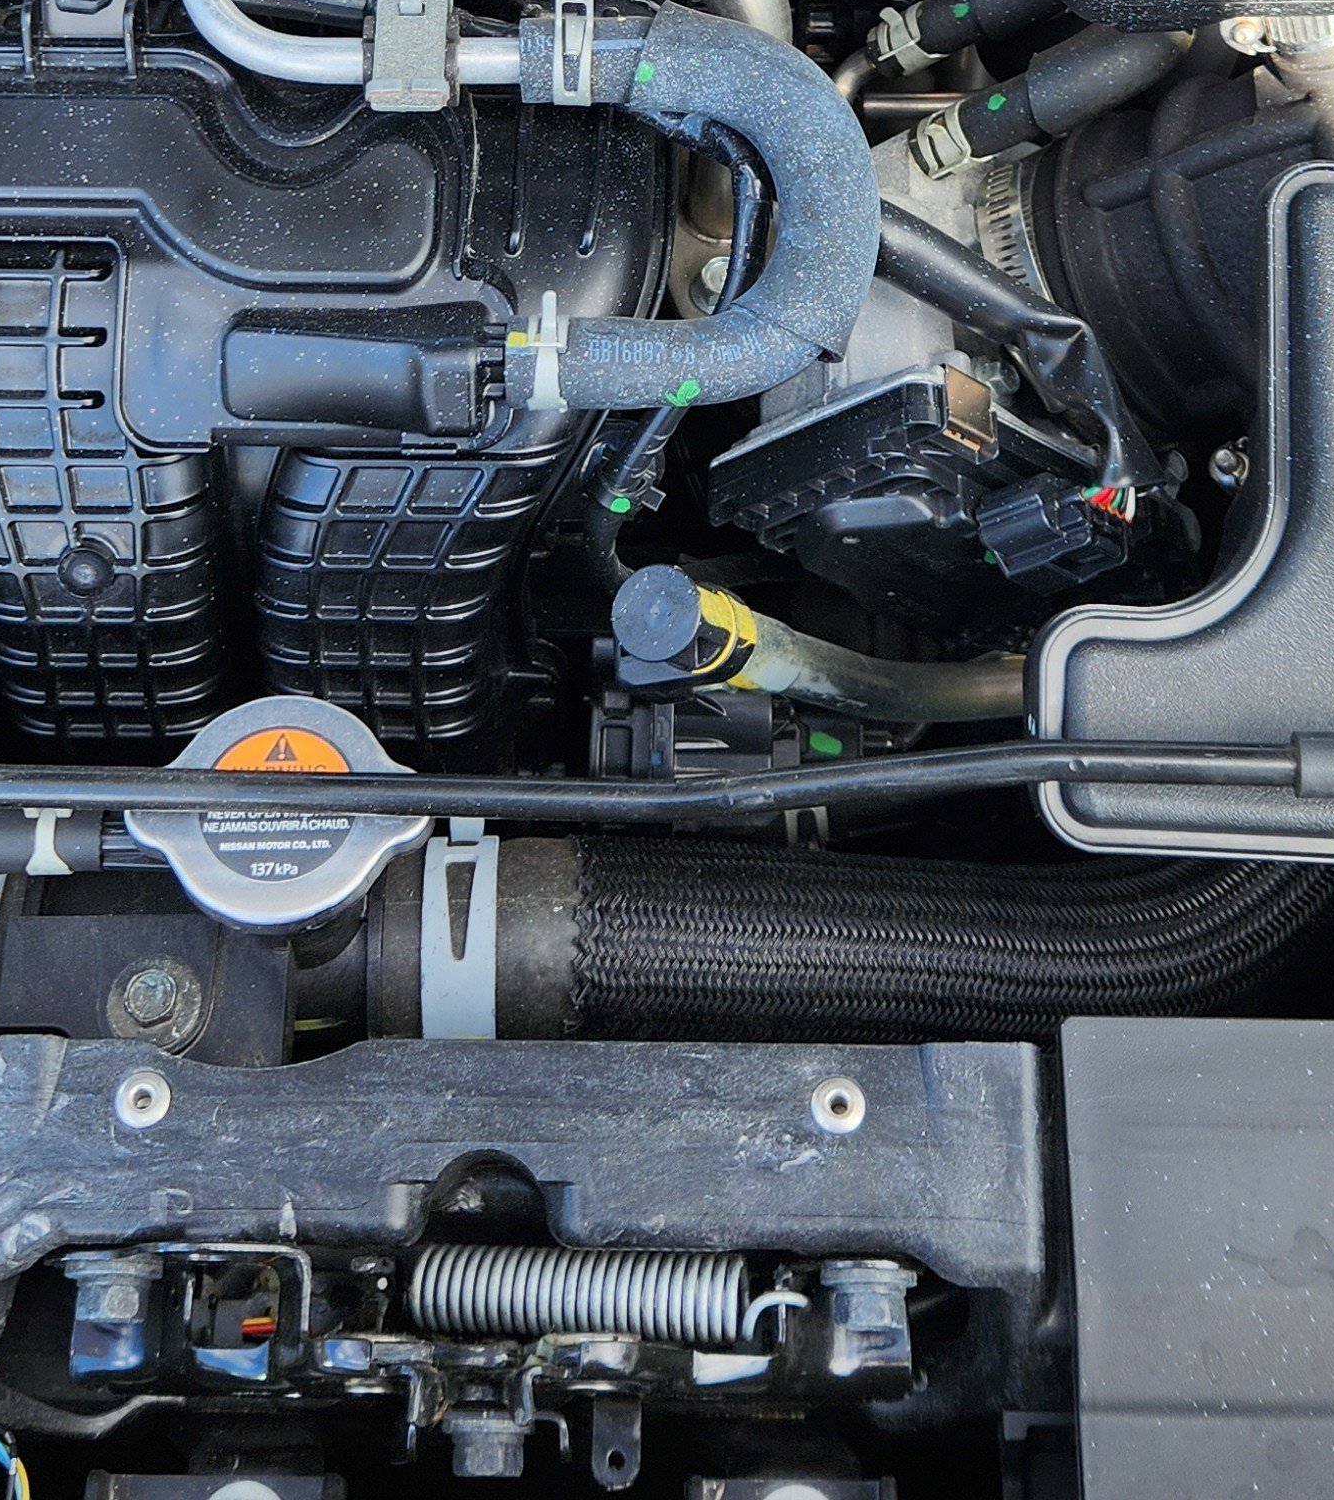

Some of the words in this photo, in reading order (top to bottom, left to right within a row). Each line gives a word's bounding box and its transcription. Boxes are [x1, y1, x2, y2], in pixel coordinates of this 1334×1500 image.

[203, 821, 218, 833] NE
[219, 820, 258, 833] JAMAIS
[258, 820, 300, 832] OUVRIR
[309, 818, 351, 831] CHAUD.
[219, 841, 255, 851] NISSAN
[257, 841, 290, 850] MOTOR
[312, 839, 333, 849] LTD.
[250, 862, 274, 876] 137
[274, 862, 299, 876] kPa
